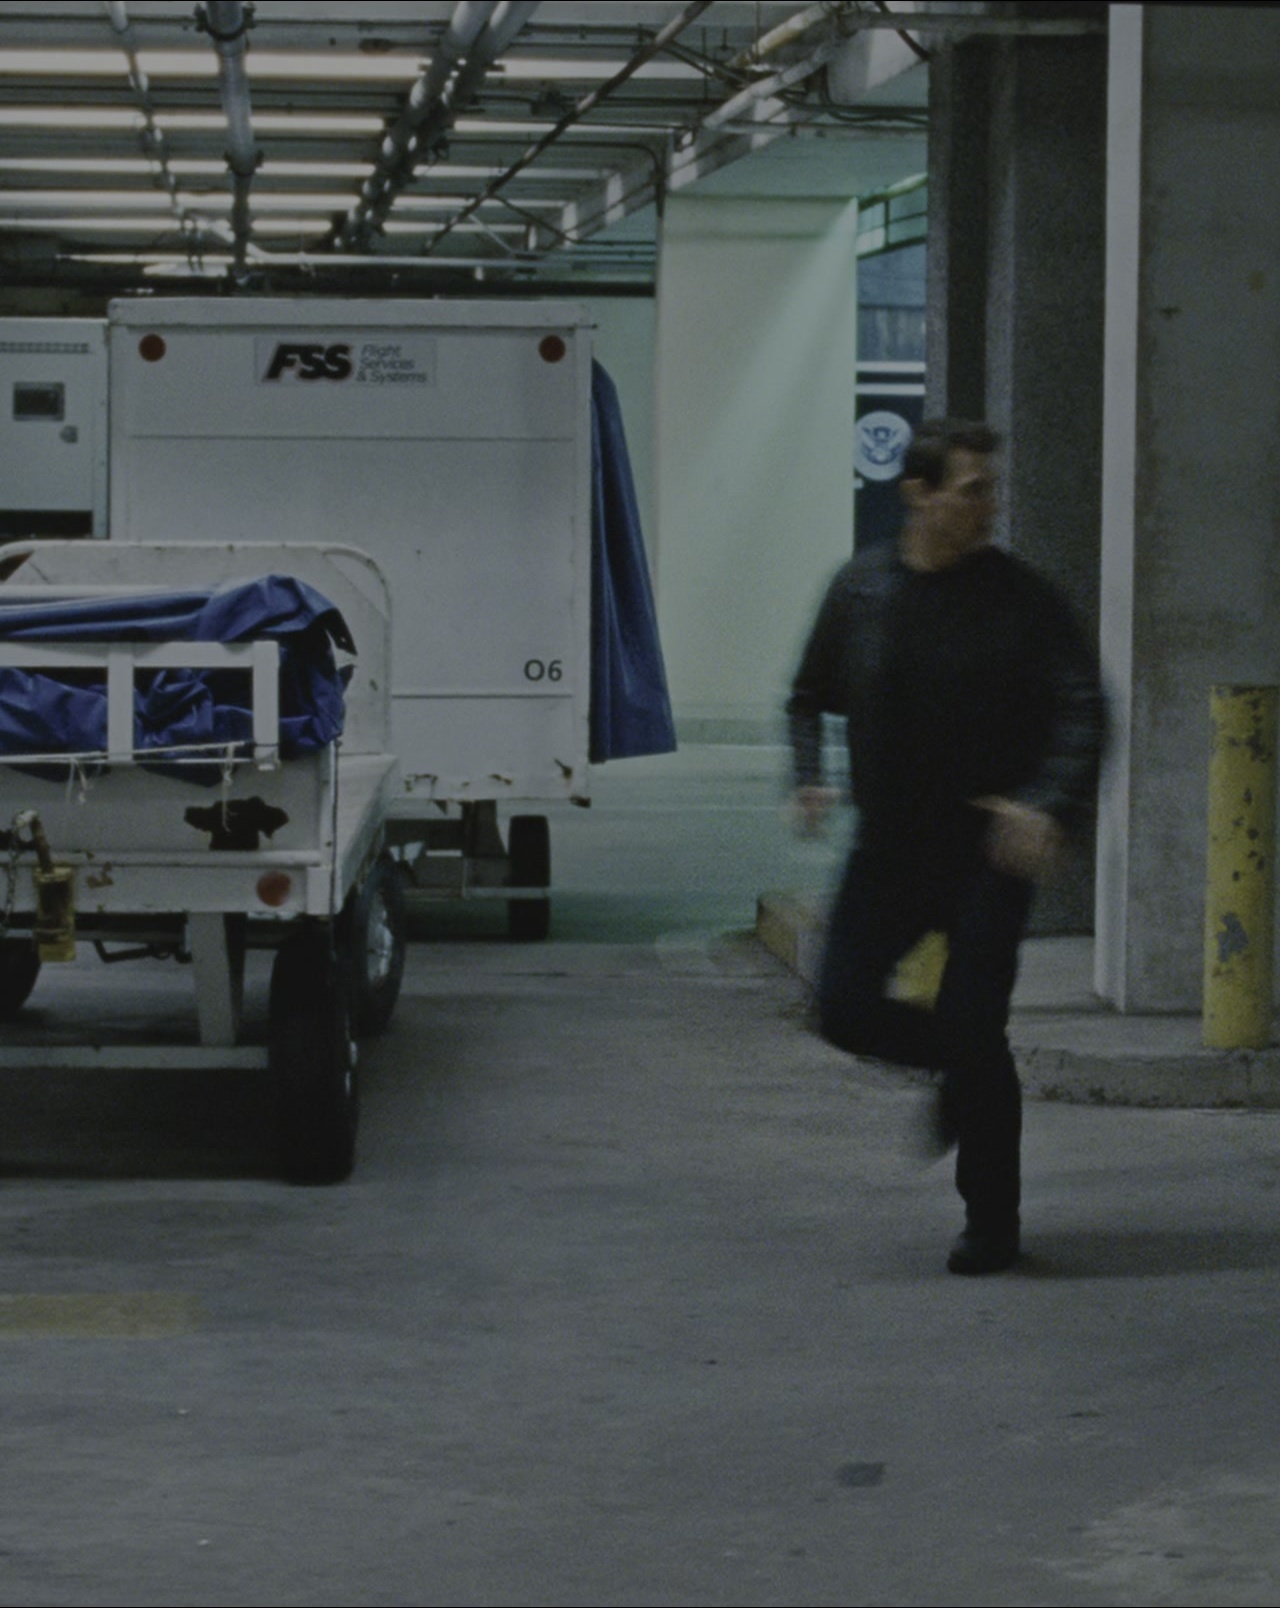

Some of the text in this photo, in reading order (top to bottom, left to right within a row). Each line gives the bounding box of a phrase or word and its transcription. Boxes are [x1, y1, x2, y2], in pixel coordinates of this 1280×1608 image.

[361, 344, 402, 358] Flight
[262, 343, 353, 382] FSS
[360, 357, 415, 370] Services
[357, 371, 427, 384] & Systems
